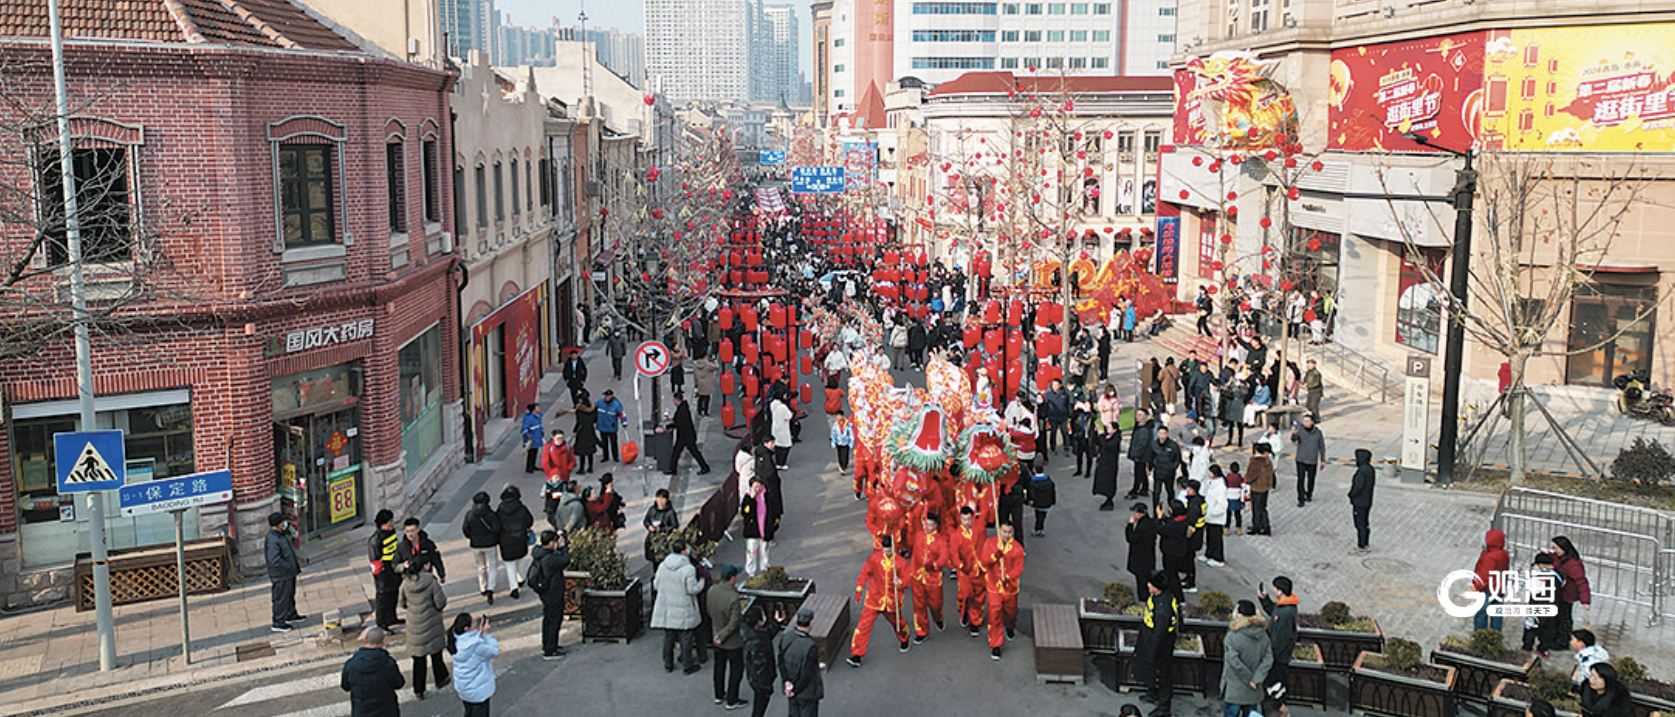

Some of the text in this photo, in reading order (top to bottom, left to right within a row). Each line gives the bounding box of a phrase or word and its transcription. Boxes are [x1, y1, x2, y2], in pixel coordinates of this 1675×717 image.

[1577, 75, 1652, 98] 第二届新春
[1387, 92, 1440, 122] 逛街里节
[1594, 89, 1675, 121] 逛街里
[286, 319, 375, 353] 国风大药房
[1413, 362, 1424, 374] P
[146, 479, 208, 501] 保定路
